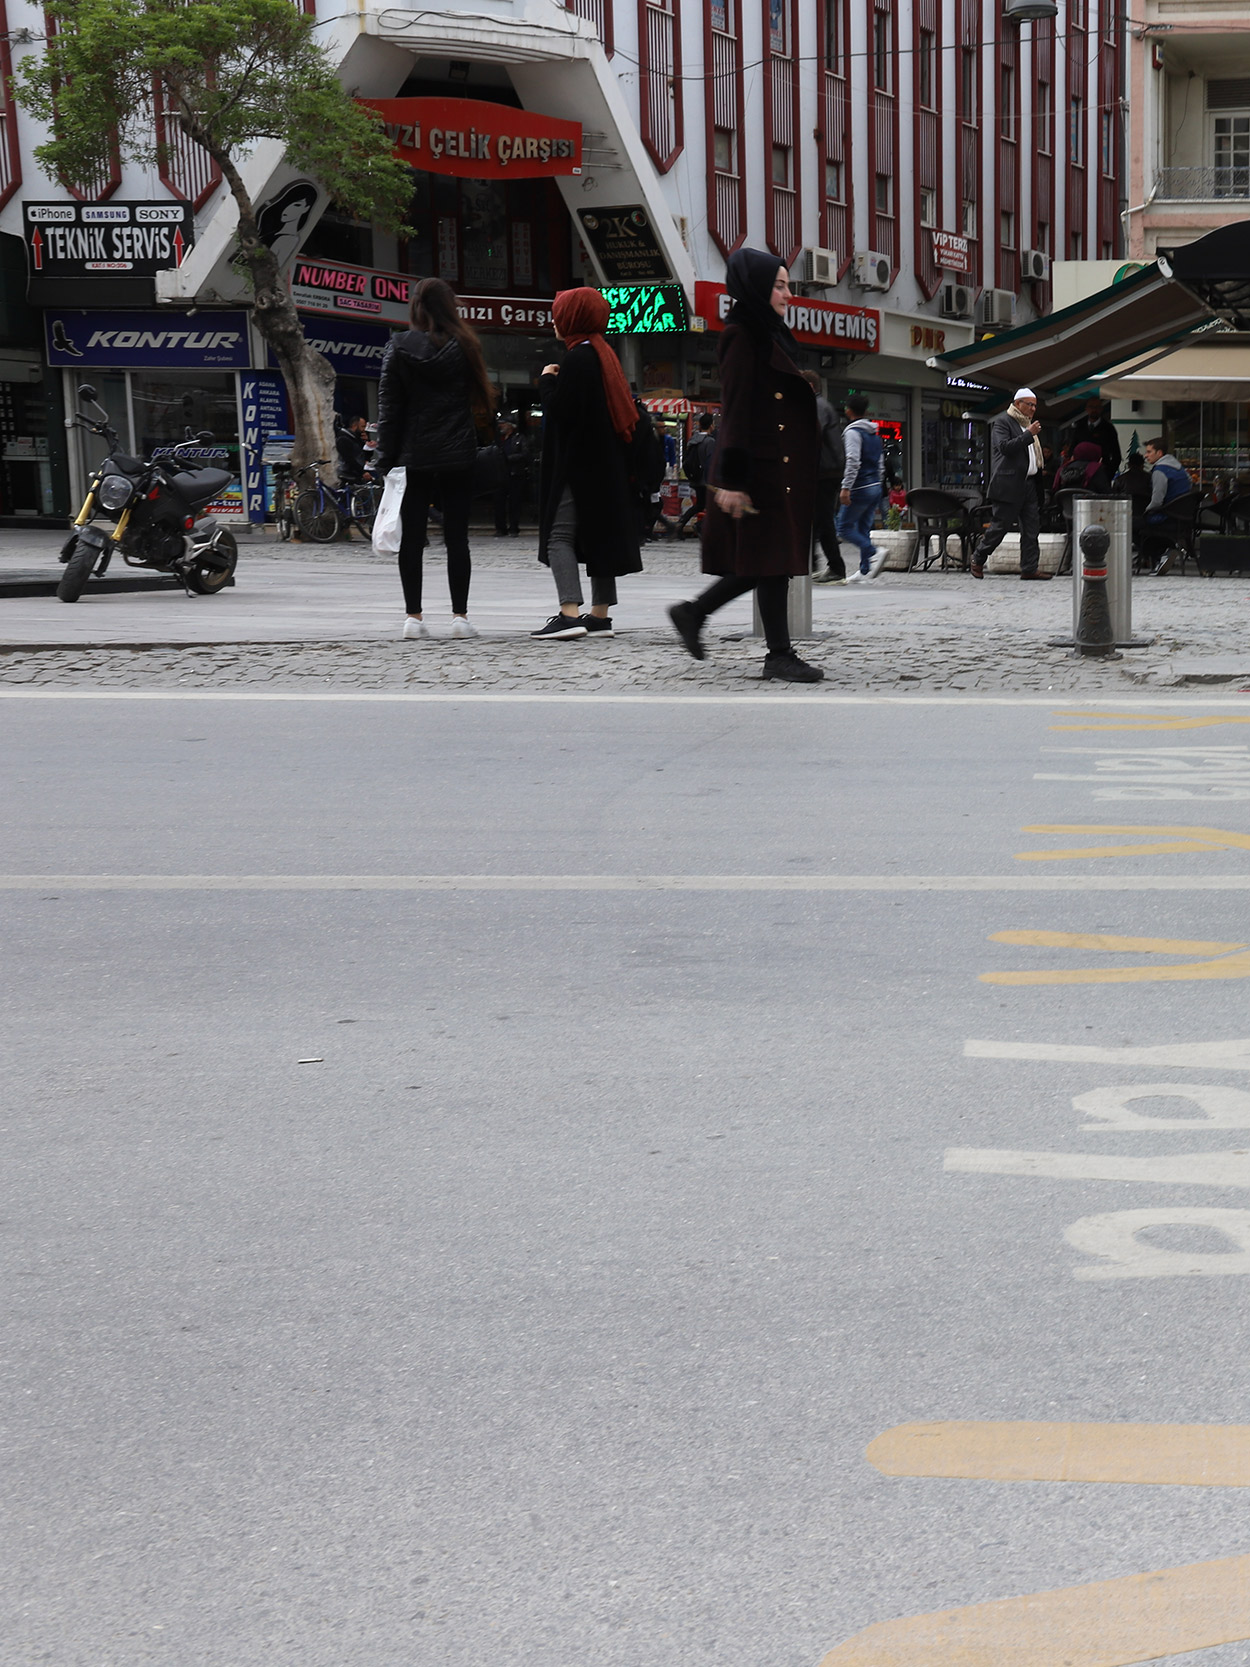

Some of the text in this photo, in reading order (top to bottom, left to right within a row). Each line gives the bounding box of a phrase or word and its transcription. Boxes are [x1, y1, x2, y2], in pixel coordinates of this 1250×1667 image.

[429, 127, 491, 159] ÇELİK
[498, 135, 575, 166] ÇARŞISI
[38, 208, 73, 219] iPhone
[85, 211, 127, 219] SAMSUNG
[139, 209, 181, 220] SONY
[602, 216, 638, 238] 2K
[298, 265, 410, 303] NUMBER ONE
[784, 303, 877, 348] URUYEMİŞ
[86, 331, 240, 348] KONTUR
